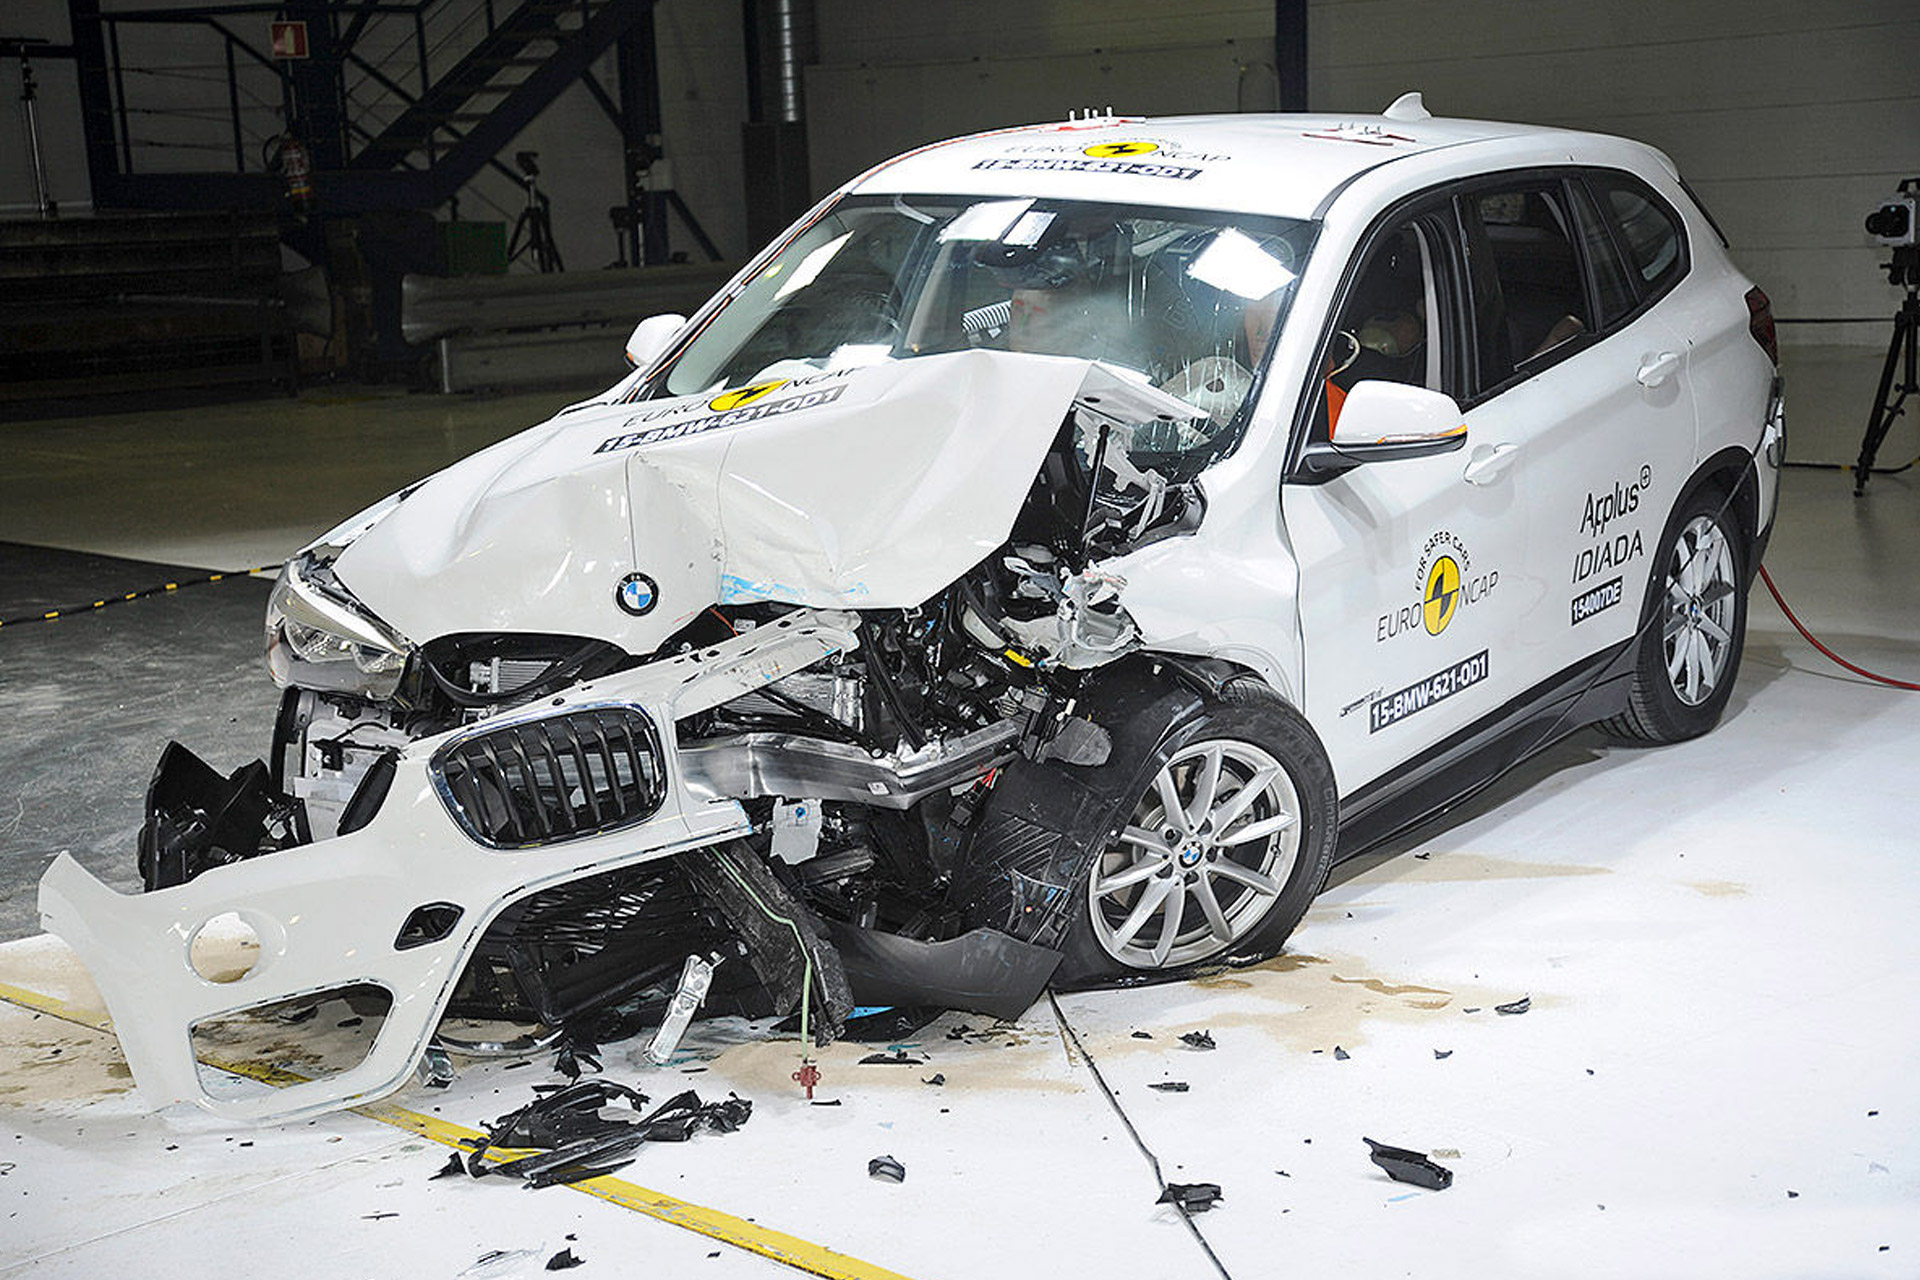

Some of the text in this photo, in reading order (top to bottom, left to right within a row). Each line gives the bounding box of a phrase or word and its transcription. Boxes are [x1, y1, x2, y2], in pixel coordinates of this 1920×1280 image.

[623, 397, 708, 427] EURO
[1414, 531, 1471, 591] FOR SAFER CARS
[1572, 530, 1643, 583] IDIADA
[1376, 571, 1499, 642] EURO NCAP
